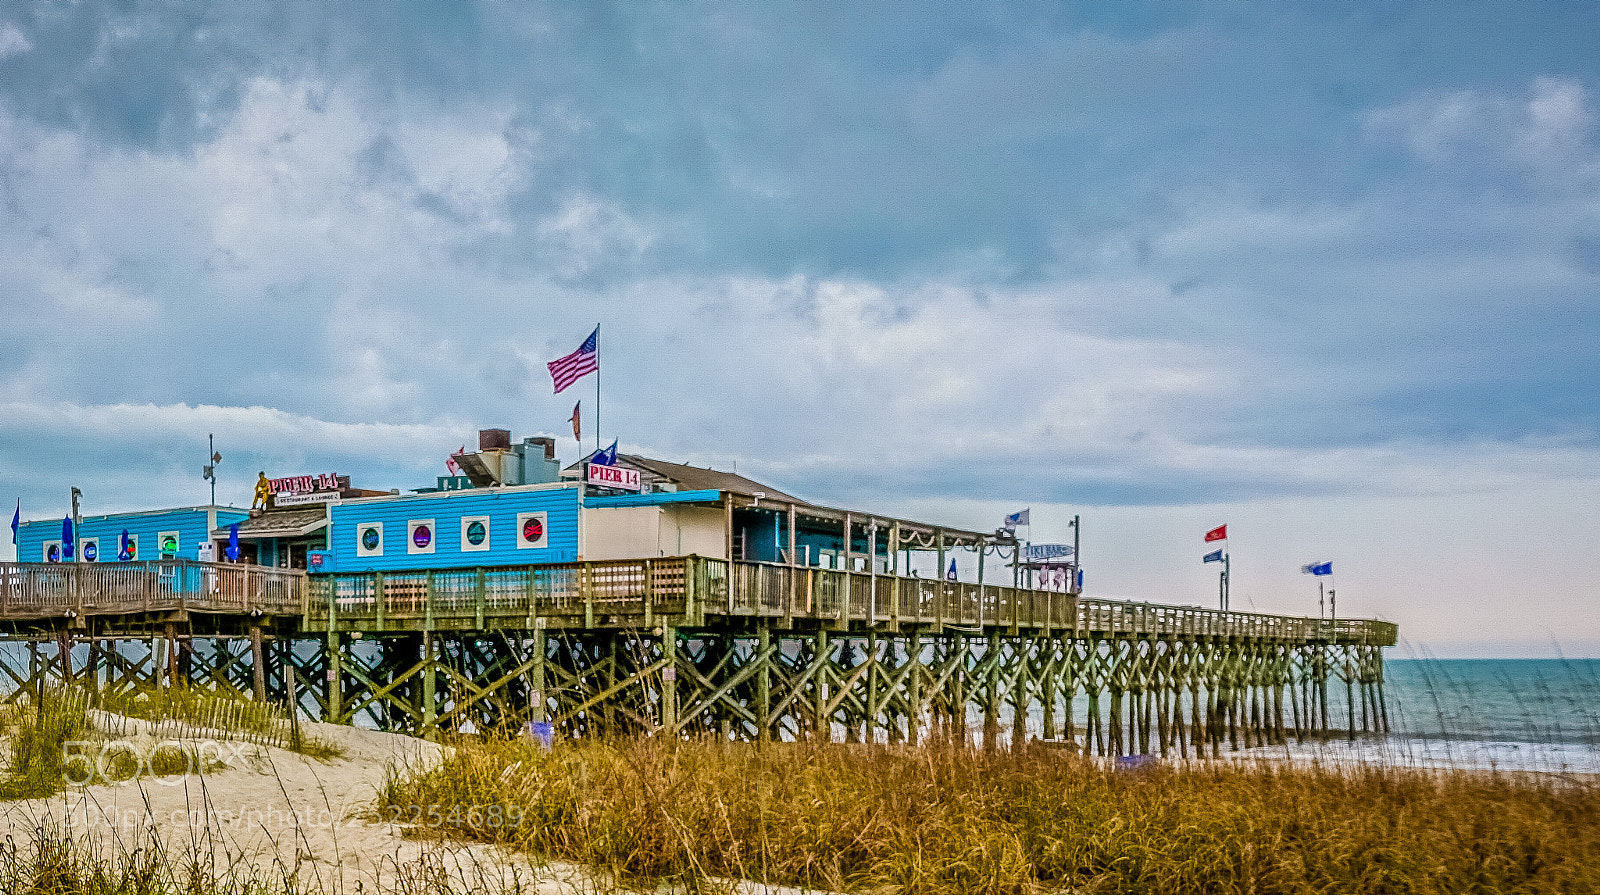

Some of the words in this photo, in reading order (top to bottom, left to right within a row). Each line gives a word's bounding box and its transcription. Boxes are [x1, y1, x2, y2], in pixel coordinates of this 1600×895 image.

[268, 475, 314, 494] PIER
[318, 473, 338, 489] 14
[590, 466, 622, 482] PIER
[626, 471, 637, 485] 14
